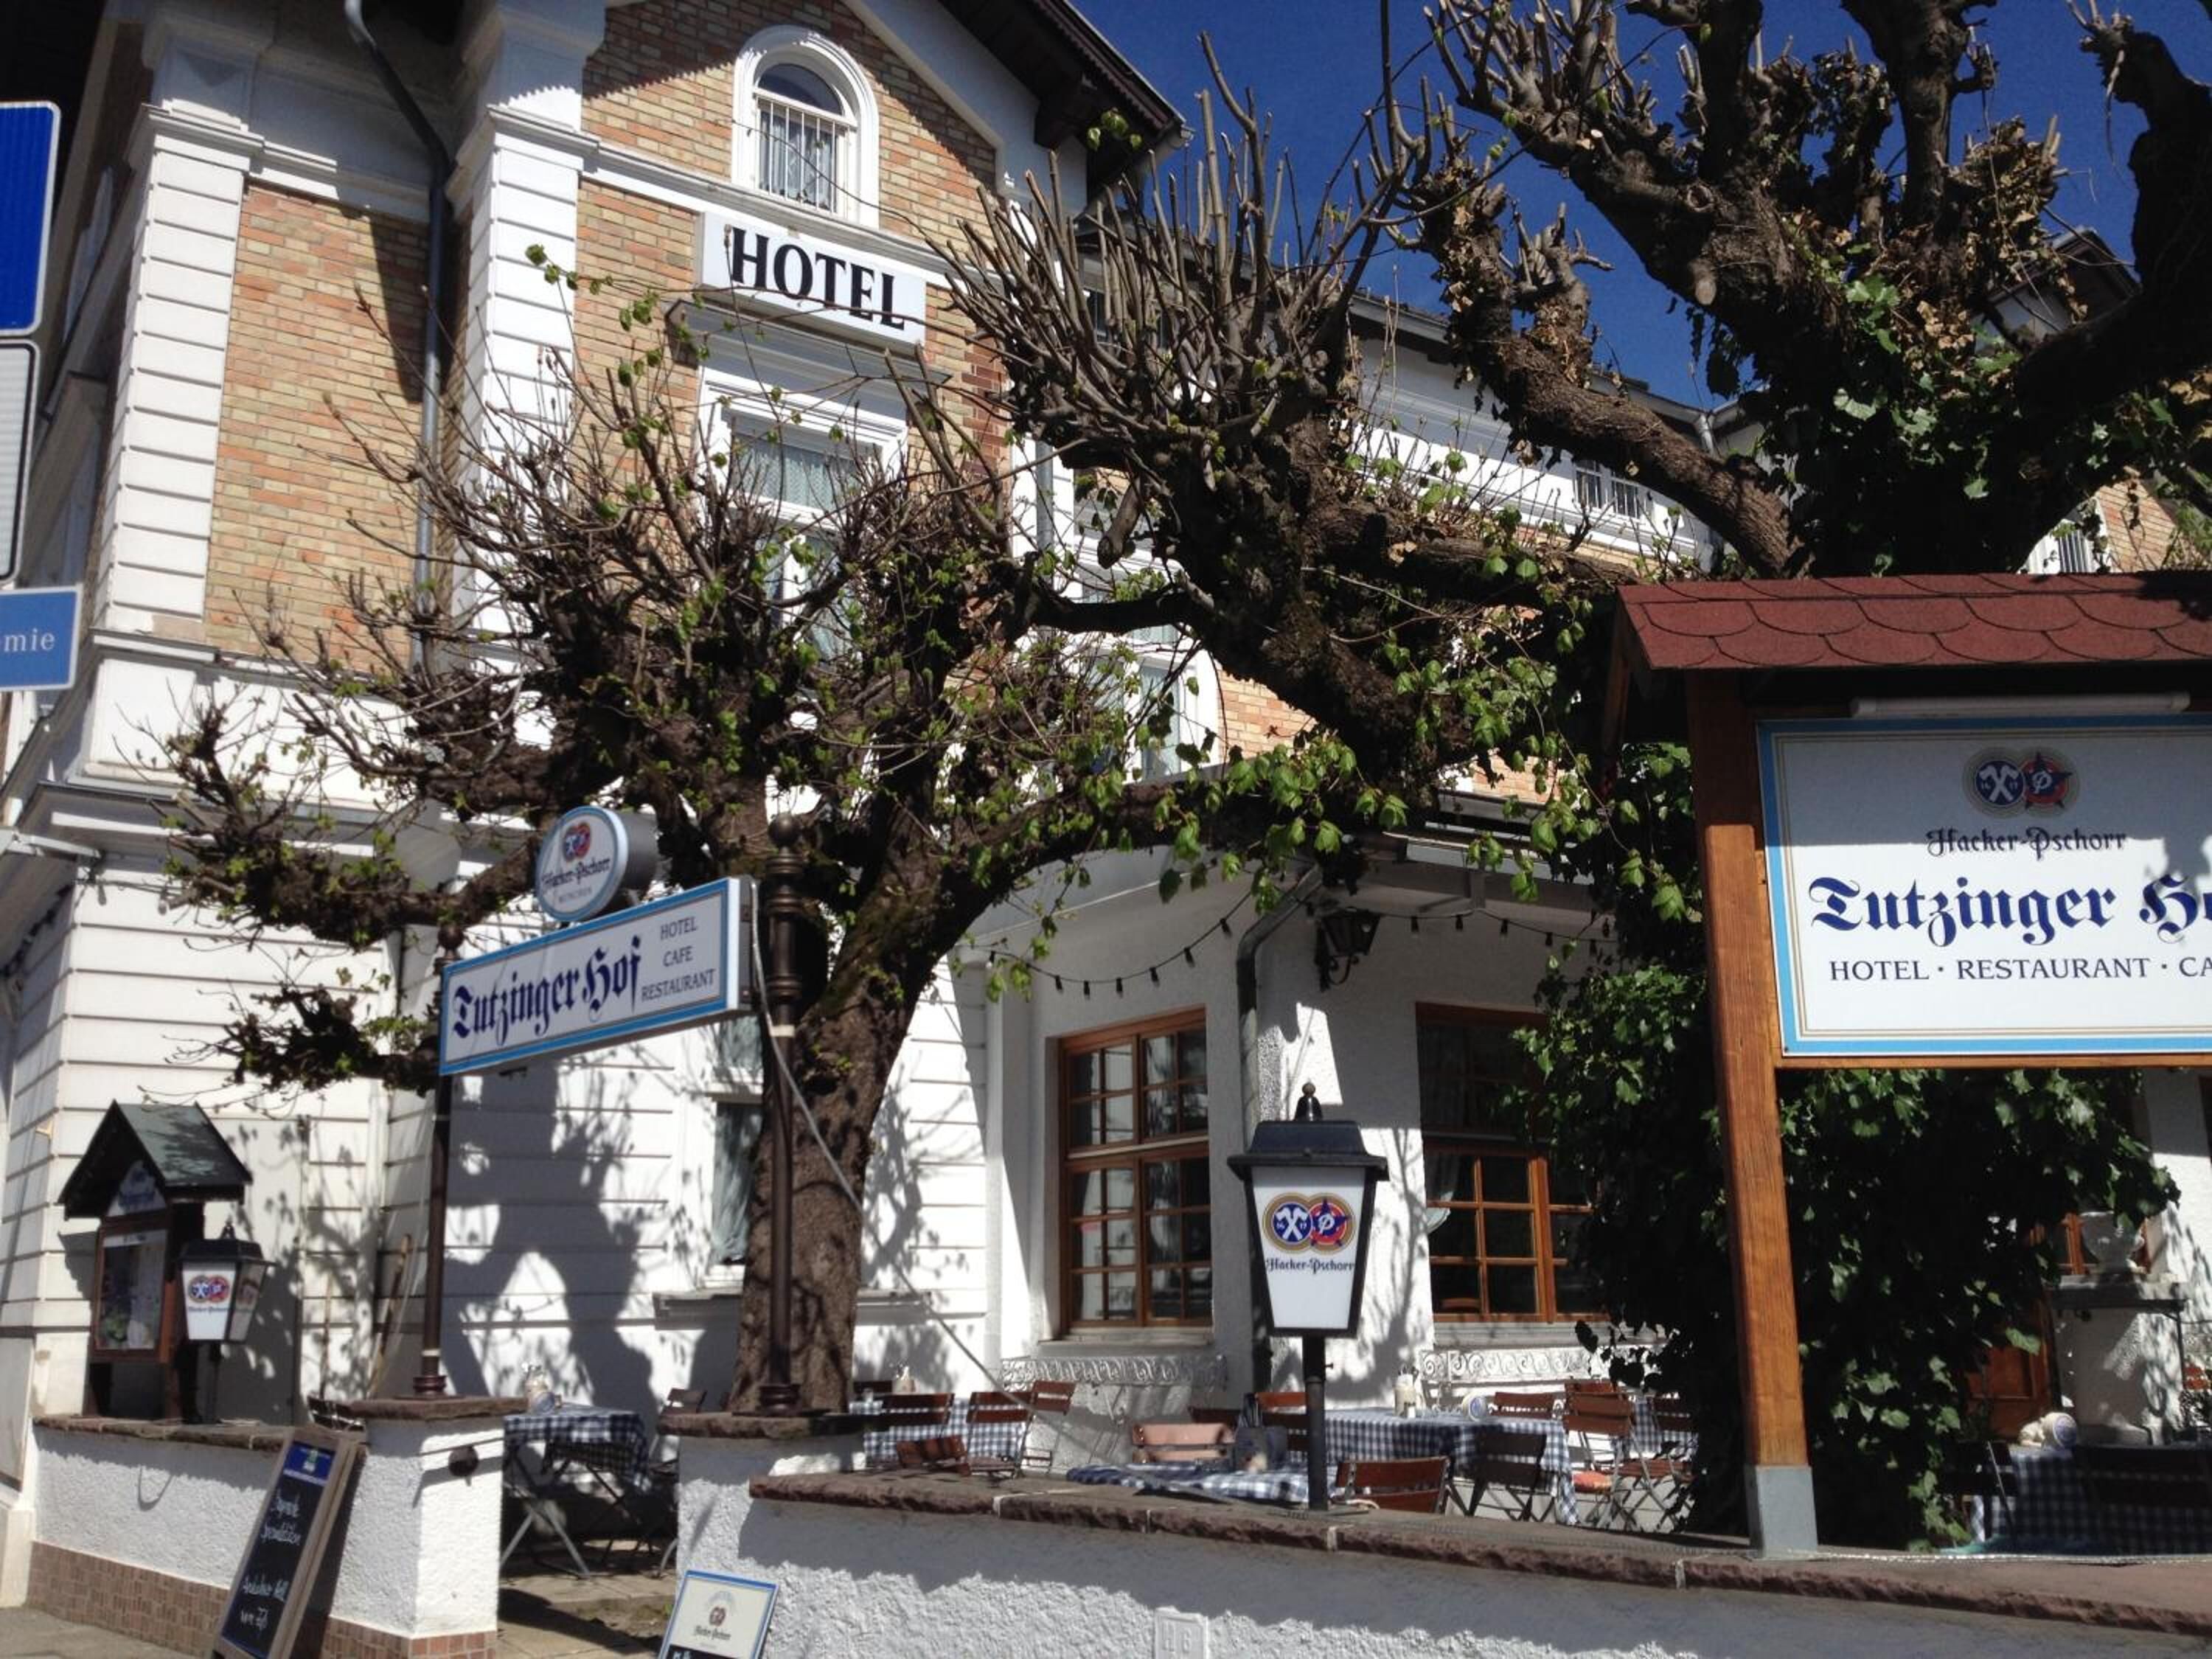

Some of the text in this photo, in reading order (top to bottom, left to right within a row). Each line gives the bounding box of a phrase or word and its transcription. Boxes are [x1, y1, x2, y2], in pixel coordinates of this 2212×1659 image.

[731, 227, 905, 330] HOTEL
[1925, 826, 2127, 861] Hacker-Pschorr
[660, 916, 698, 941] HOTEL
[1809, 876, 2117, 948] Tutzinger
[664, 945, 694, 968] CAFE
[1830, 960, 1930, 981] HOTEL
[1957, 957, 2151, 981] RESTAURANT
[452, 934, 642, 1047] Tutzinger Hof
[641, 968, 716, 1003] RESTAURANT
[1266, 1258, 1356, 1274] Hacker-Pschorr
